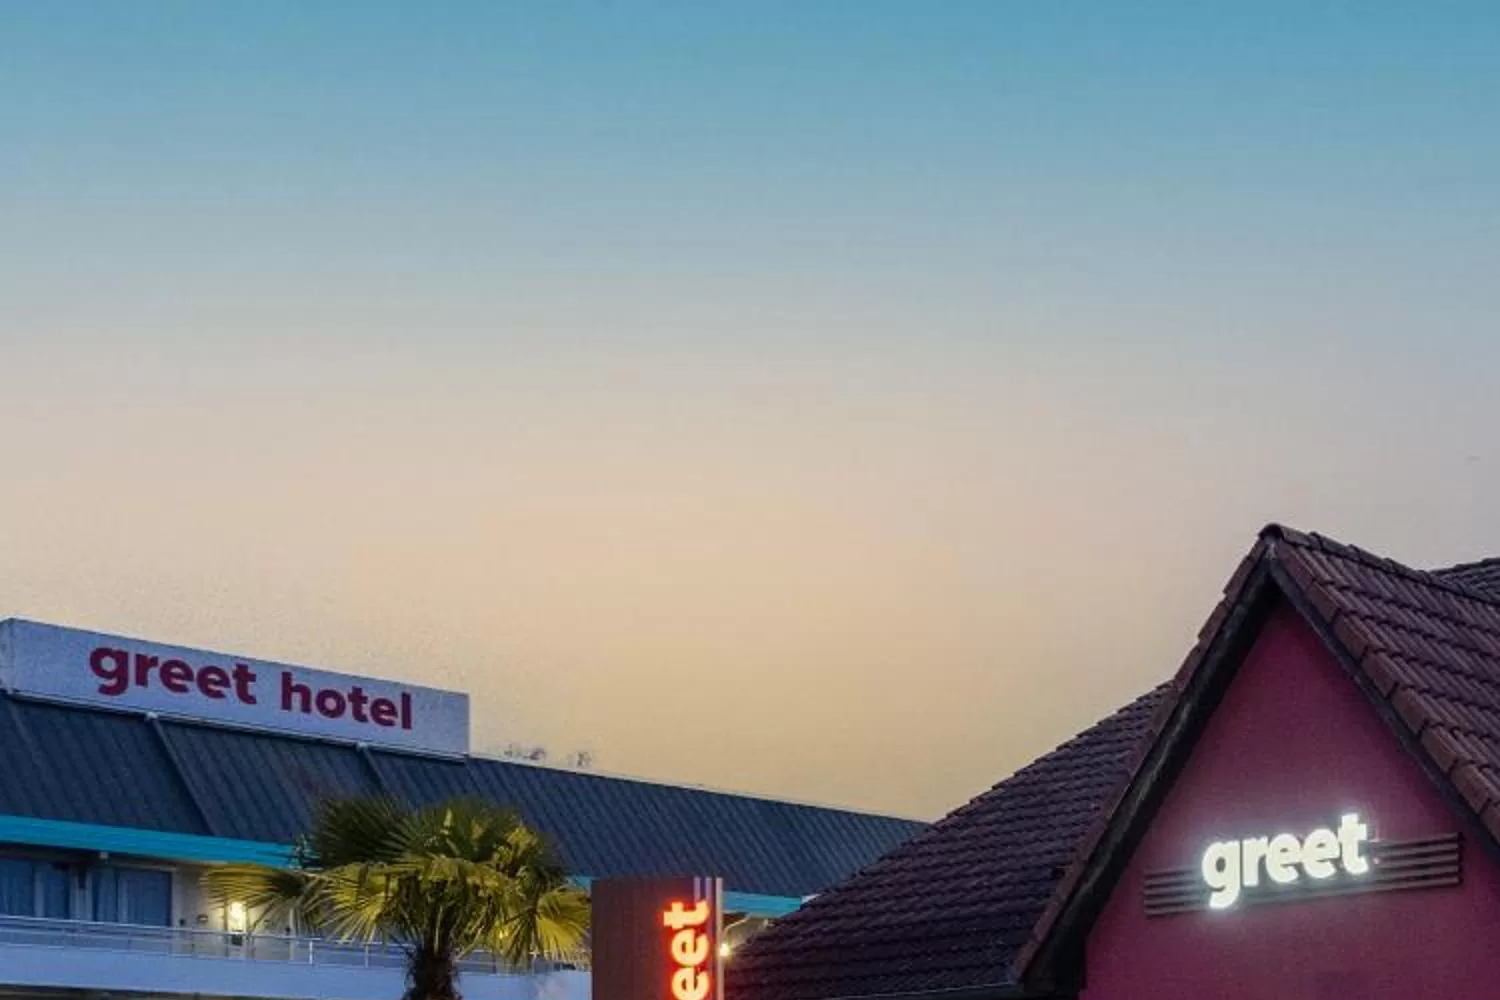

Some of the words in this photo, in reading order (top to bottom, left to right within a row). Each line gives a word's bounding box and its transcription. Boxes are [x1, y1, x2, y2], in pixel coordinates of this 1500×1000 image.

[88, 646, 257, 705] greet
[280, 671, 412, 730] hotel
[1202, 812, 1369, 909] greet
